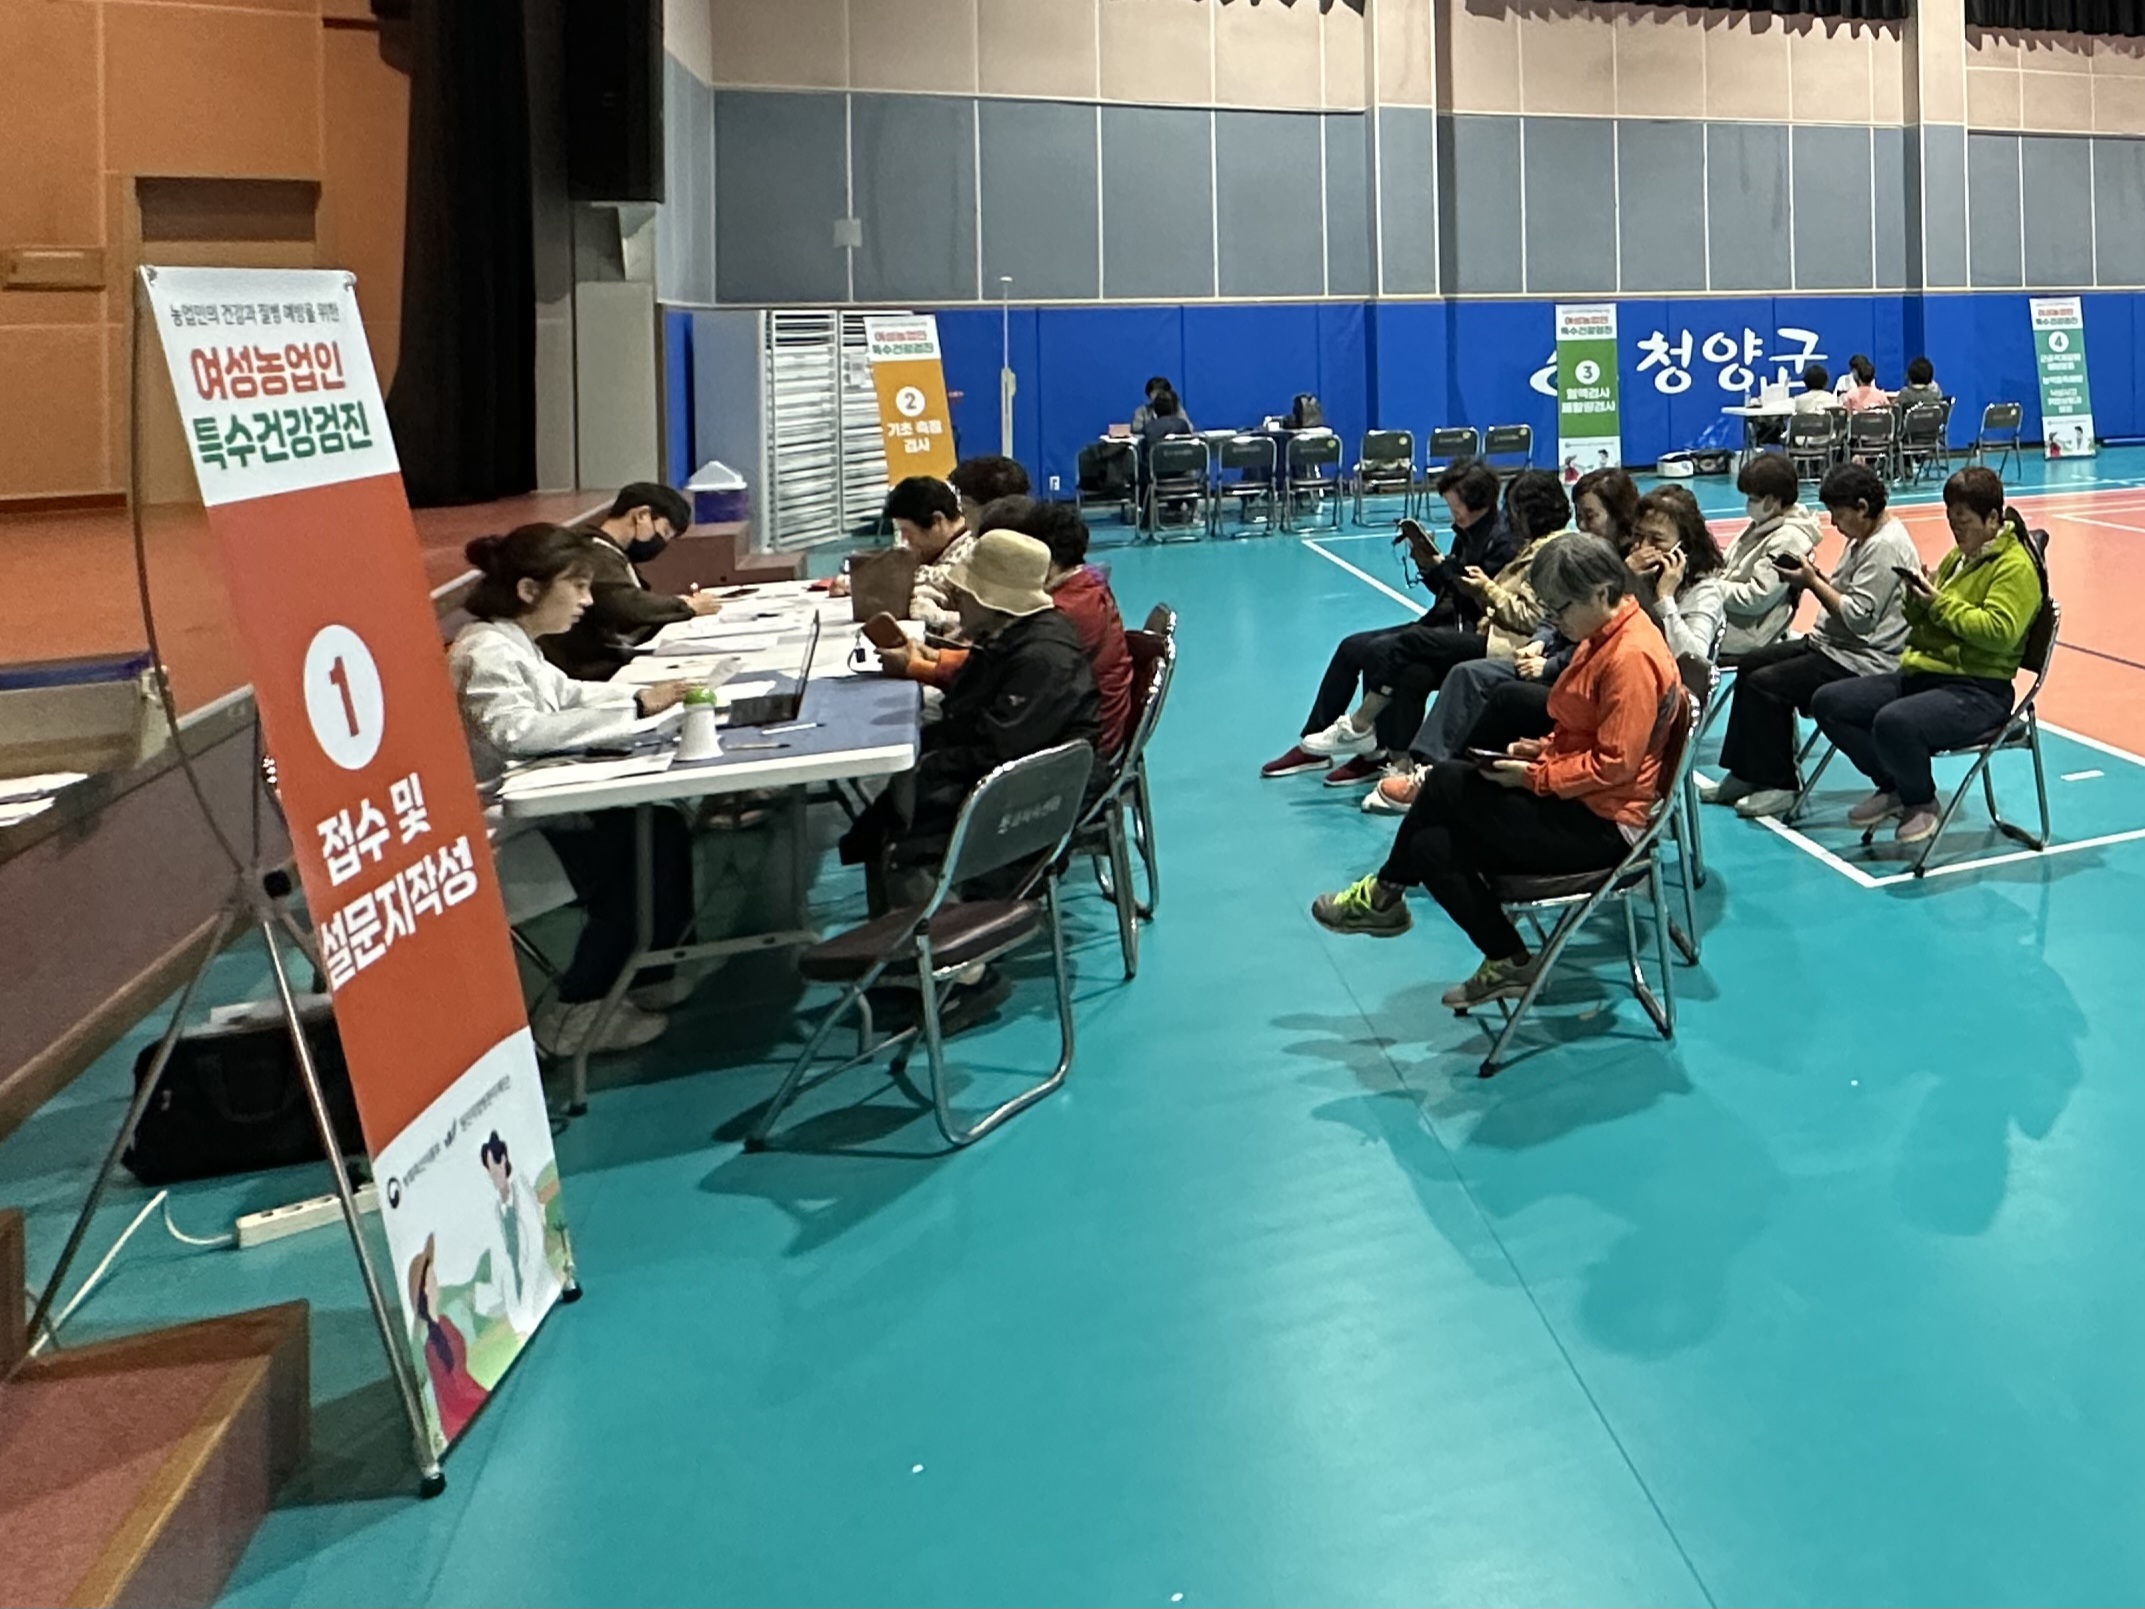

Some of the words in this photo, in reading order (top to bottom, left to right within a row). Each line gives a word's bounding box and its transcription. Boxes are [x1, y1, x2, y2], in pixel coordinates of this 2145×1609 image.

[190, 341, 346, 401] 여성농업인
[1582, 366, 1593, 379] 3
[1637, 328, 1829, 394] 청양군
[887, 422, 914, 438] 기초
[904, 392, 917, 410] 2
[192, 400, 373, 470] 특수건강검진
[903, 437, 930, 454] 검사
[329, 655, 360, 738] 1
[316, 798, 391, 887] 접수
[389, 772, 431, 844] 및
[320, 835, 478, 991] 설문지작성
